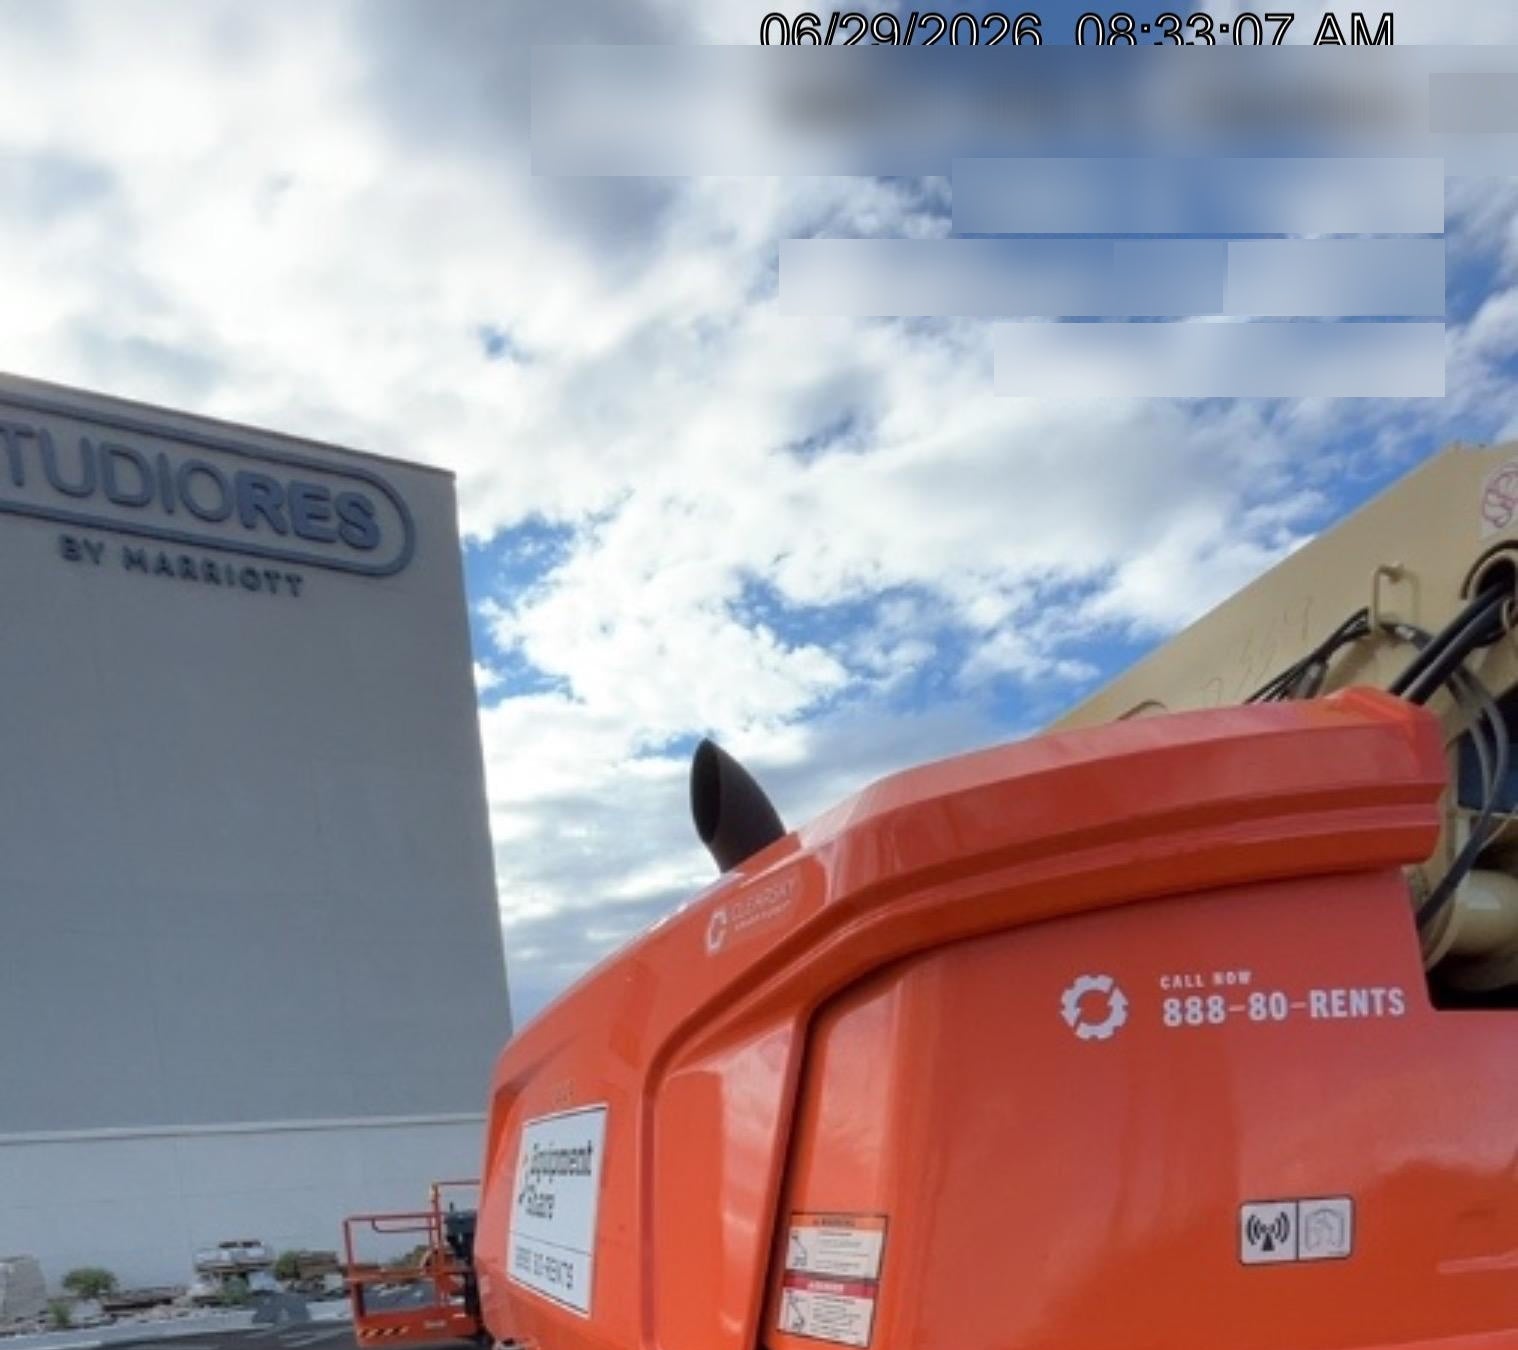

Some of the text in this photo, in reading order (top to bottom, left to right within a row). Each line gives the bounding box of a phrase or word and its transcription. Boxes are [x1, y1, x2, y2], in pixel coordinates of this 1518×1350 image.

[58, 533, 304, 598] BY MARRIOTT
[1160, 970, 1252, 990] CALL NOW
[1163, 987, 1406, 1027] 888-80-RENTS
